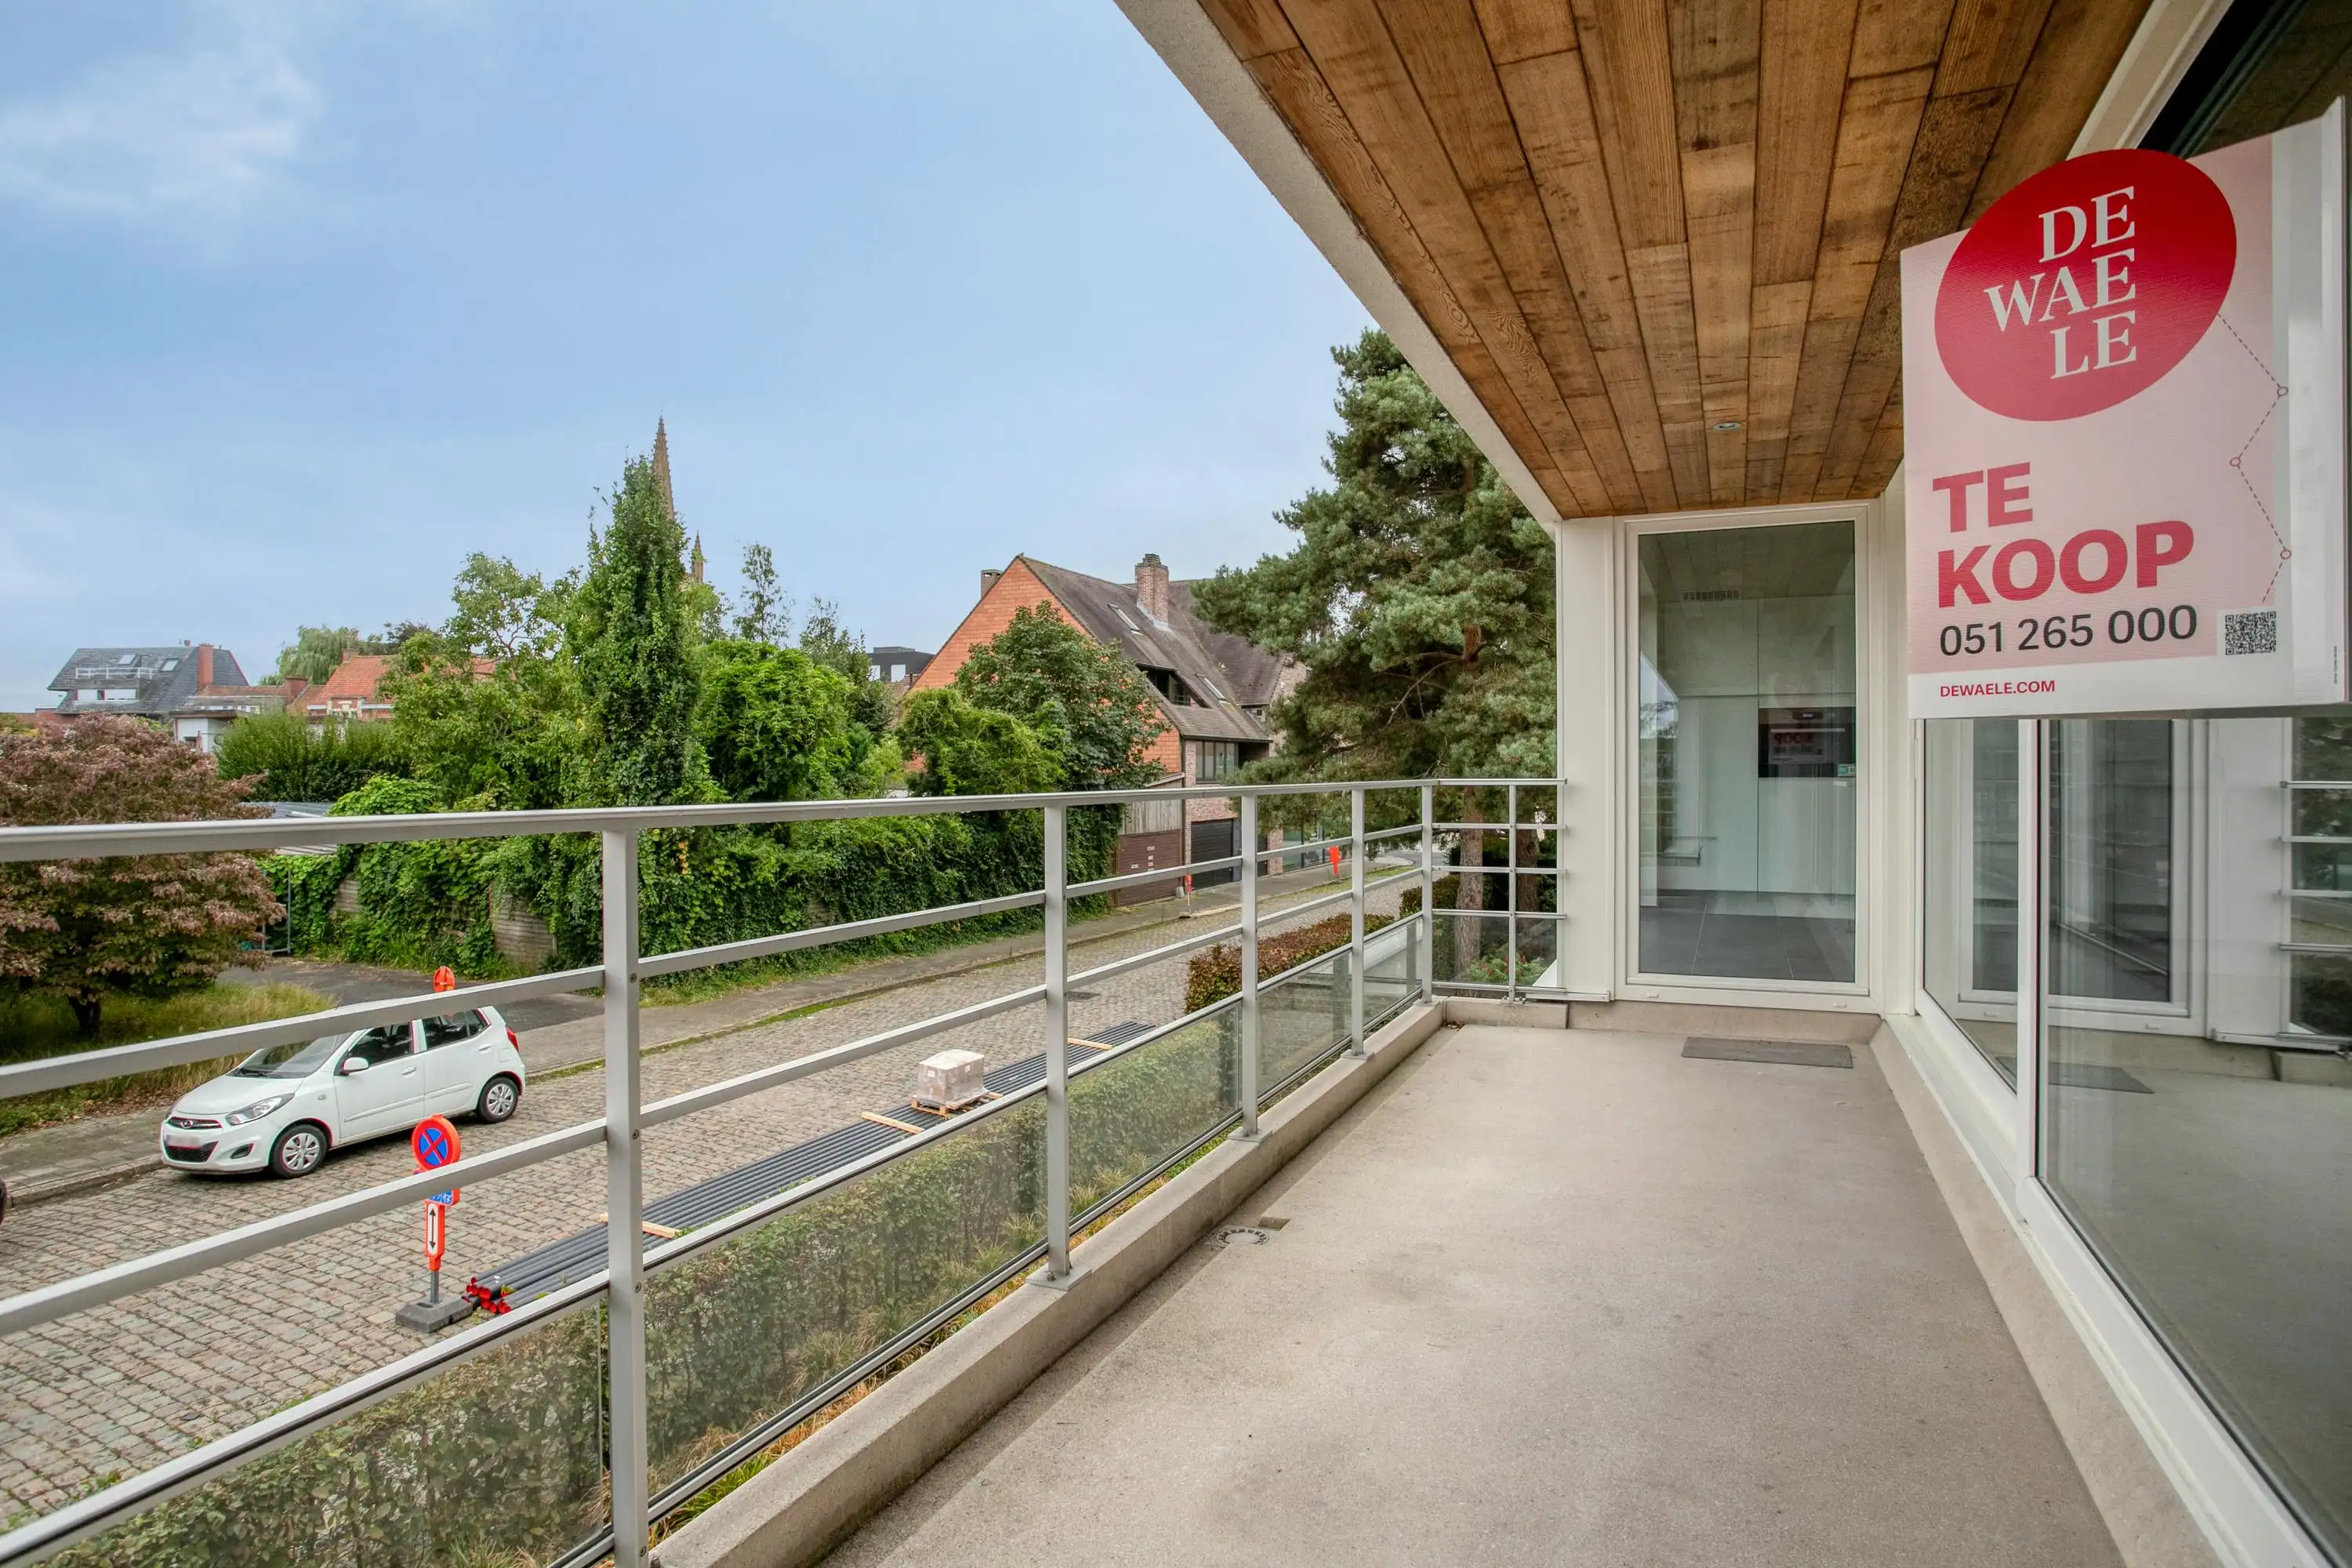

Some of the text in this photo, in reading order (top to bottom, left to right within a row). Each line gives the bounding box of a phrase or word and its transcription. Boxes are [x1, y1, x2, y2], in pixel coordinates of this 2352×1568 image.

[2038, 186, 2135, 263] DE
[1984, 249, 2136, 332] WAE
[2050, 310, 2136, 379] LE
[1932, 462, 2033, 533] TE
[1938, 520, 2194, 608] KOOP
[1940, 604, 2198, 656] 051 265 000
[1940, 680, 2056, 697] DEWAELE.COM
